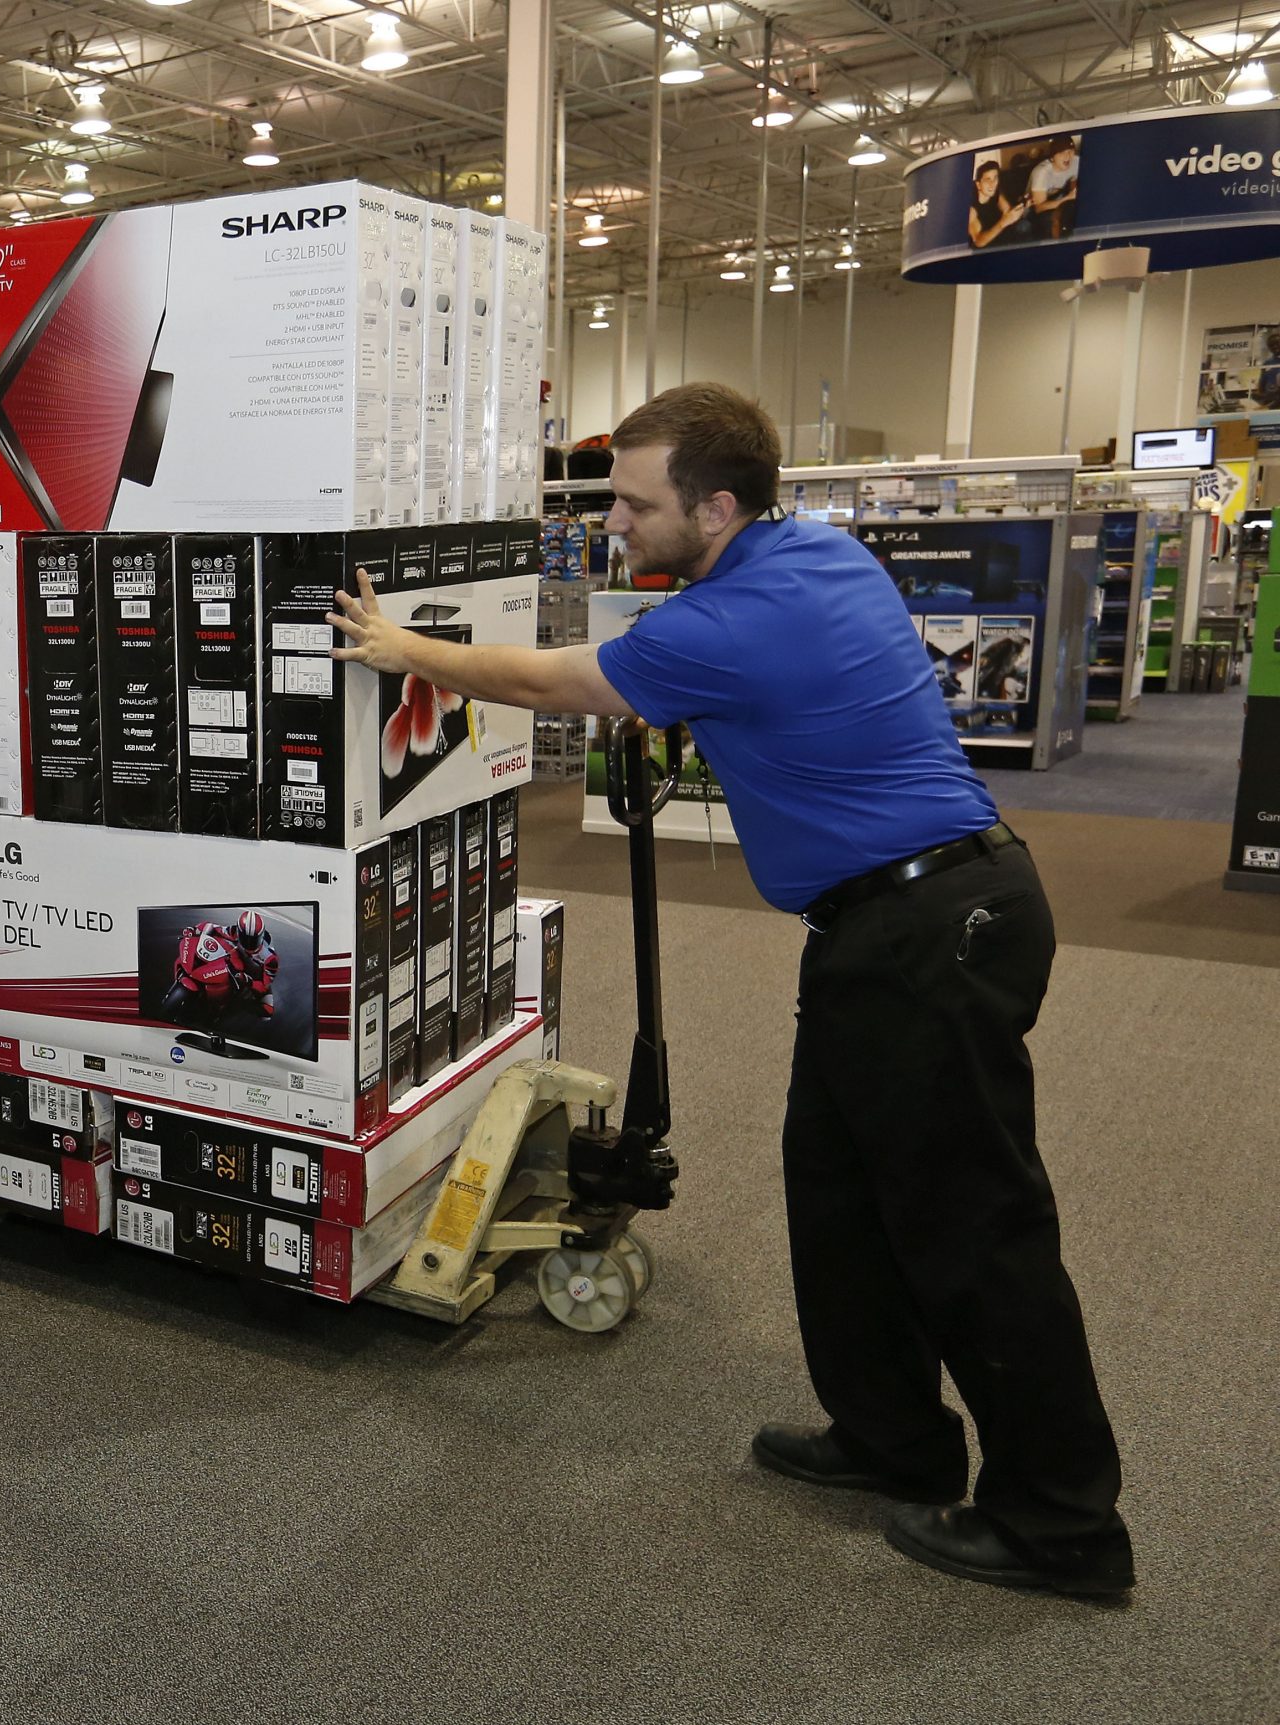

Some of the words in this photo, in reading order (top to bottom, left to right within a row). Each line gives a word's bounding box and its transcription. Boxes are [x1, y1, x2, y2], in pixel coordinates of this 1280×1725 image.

[1166, 144, 1264, 178] video
[359, 198, 385, 213] SHARP
[394, 210, 419, 223] SHARP
[222, 205, 346, 239] SHARP
[265, 242, 346, 262] LC-32LB150U
[10, 259, 26, 267] CLASS
[0, 280, 13, 292] TV
[320, 286, 345, 295] DISPLAY
[316, 298, 345, 308] ENABLED
[316, 310, 345, 319] ENABLED
[325, 323, 345, 331] INPUT
[265, 338, 290, 347] ENERGY
[307, 334, 344, 344] COMPLIANT
[1207, 341, 1249, 350] PROMISE
[272, 361, 304, 370] PANTALLA
[248, 374, 286, 383] COMPATIBLE
[269, 385, 308, 394] COMPATIBLE
[291, 397, 321, 405] ENTRADA
[229, 410, 260, 419] SATISFACE
[302, 407, 327, 416] ENERGY
[319, 487, 343, 495] HDMI
[883, 532, 920, 542] PS4
[891, 551, 939, 560] GREATNESS
[939, 550, 971, 560] AWAITS
[41, 585, 67, 593] FRAGILE
[115, 586, 143, 594] FRAGILE
[195, 588, 222, 596] FRAGILE
[43, 625, 80, 634] TOSHIBA
[117, 627, 156, 636] TOSHIBA
[195, 631, 236, 640] TOSHIBA
[48, 638, 75, 646] 32L1300U
[121, 640, 151, 648] 32L1300U
[120, 697, 153, 706] DYNALIGHT
[131, 728, 154, 737] Dynamic
[286, 733, 318, 741] 32L1300U
[280, 745, 324, 755] TOSHIBA
[490, 754, 527, 779] TOSHIBA
[295, 789, 323, 797] FRAGILE
[15, 871, 40, 883] Good
[2, 899, 28, 921] TV
[42, 904, 69, 927] TV
[74, 909, 114, 933] LED
[4, 924, 42, 949] DEL
[128, 1067, 152, 1077] TRIPLE
[144, 1115, 154, 1131] LG
[309, 1161, 319, 1204] HDMI
[143, 1211, 154, 1247] 32LN520B
[301, 1233, 311, 1274] HDMI
